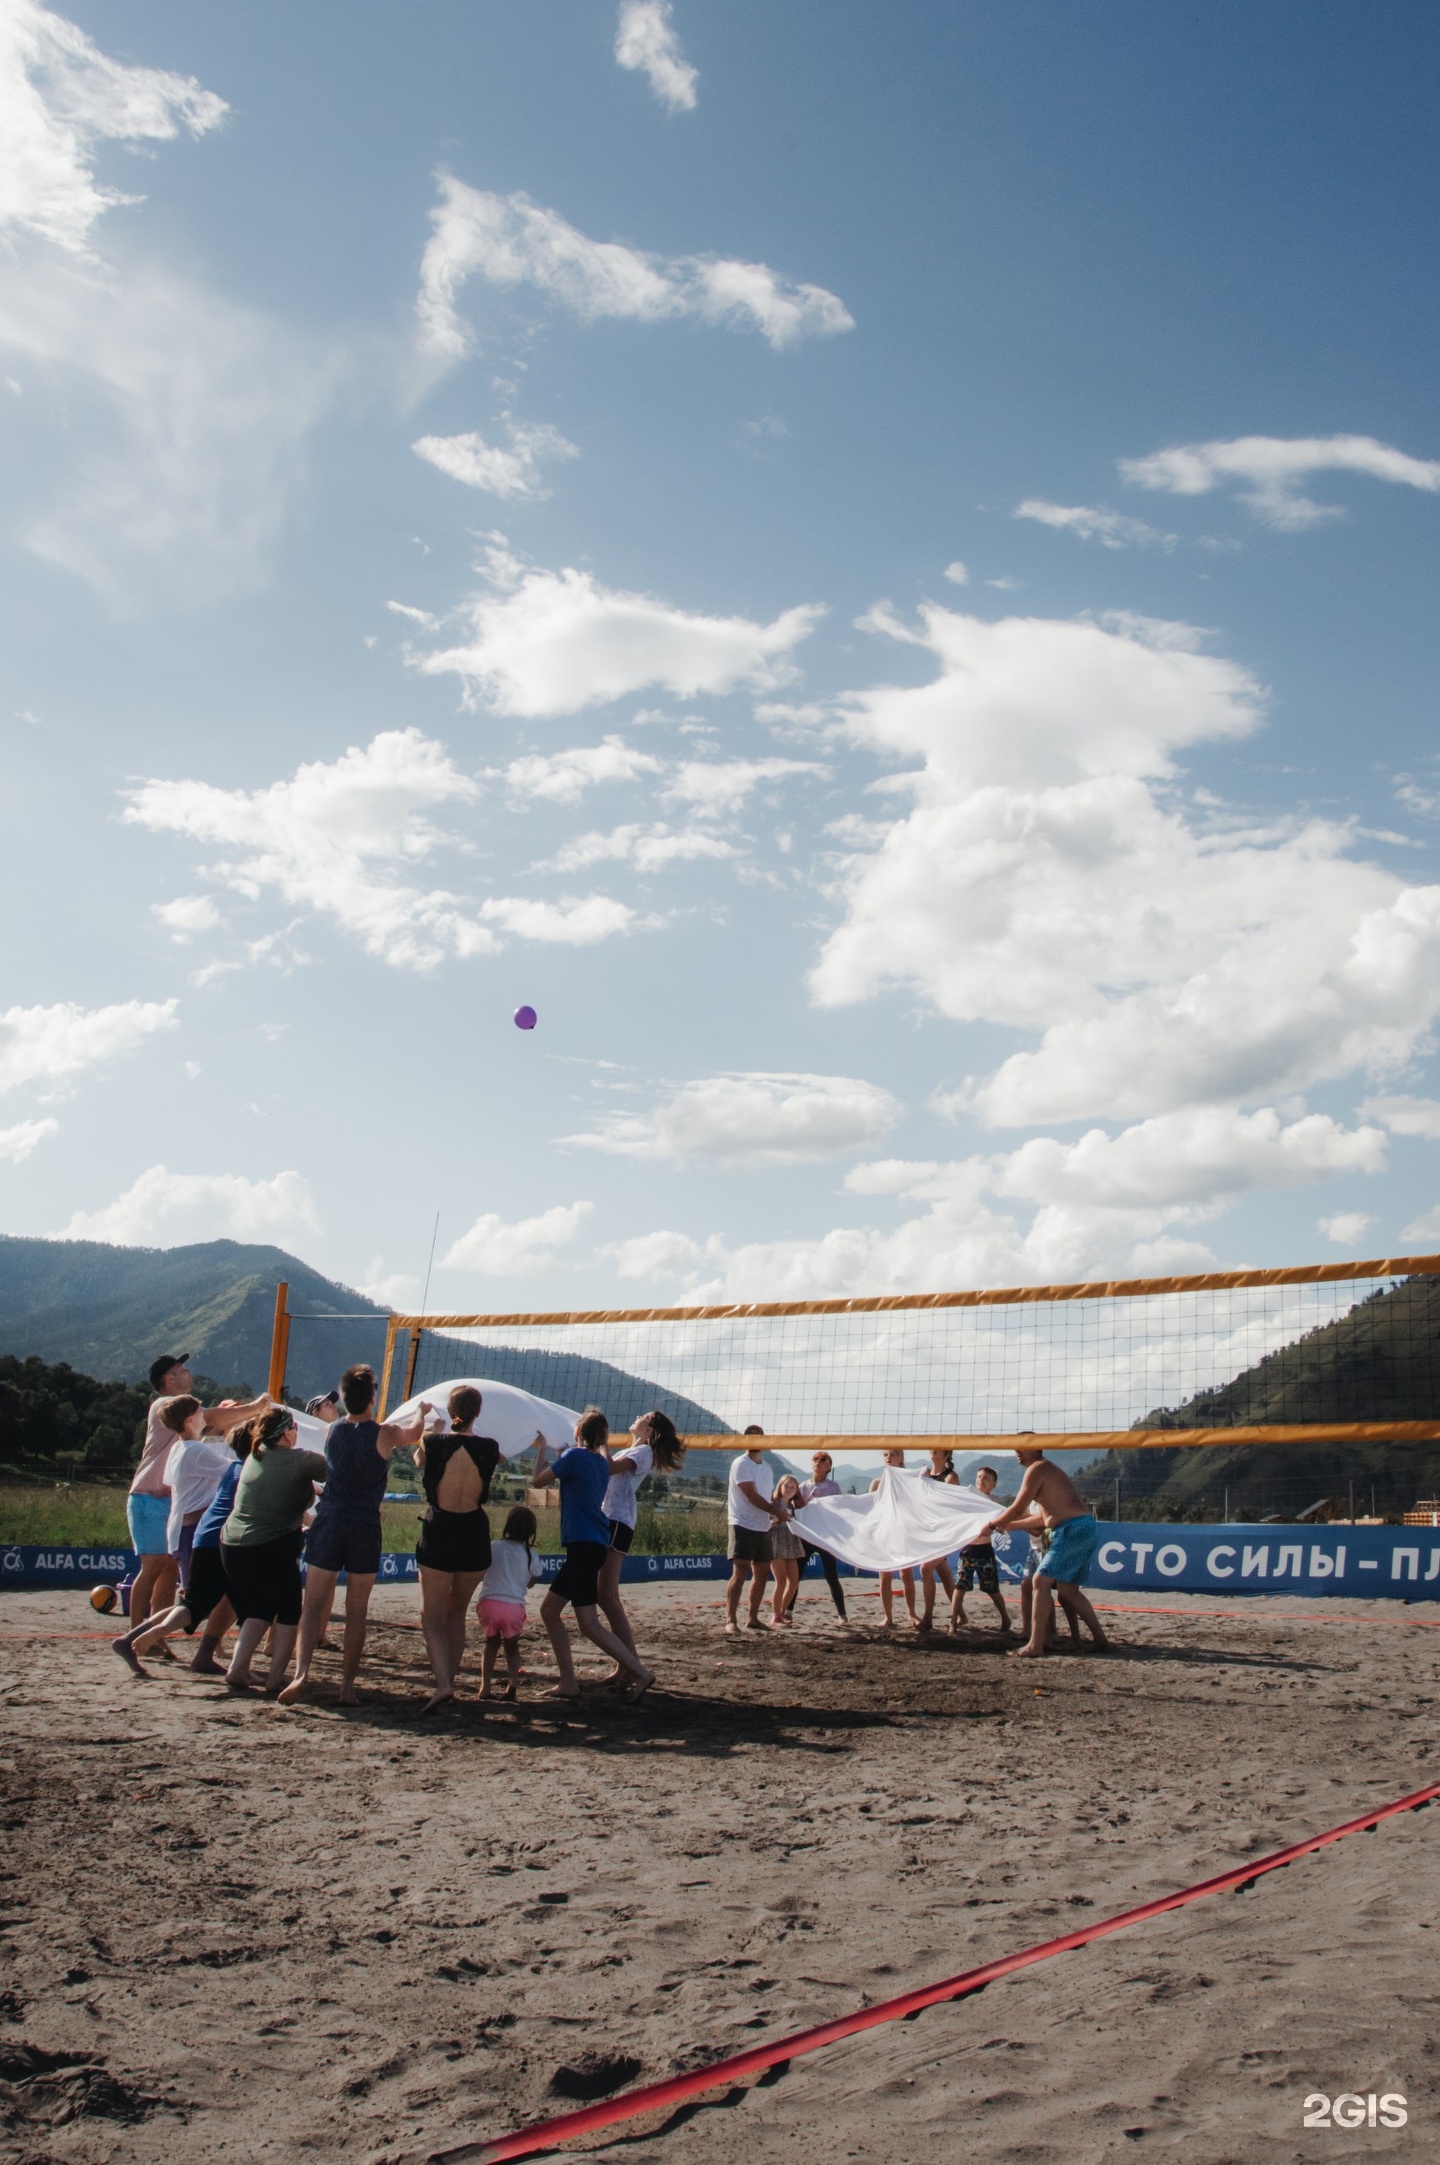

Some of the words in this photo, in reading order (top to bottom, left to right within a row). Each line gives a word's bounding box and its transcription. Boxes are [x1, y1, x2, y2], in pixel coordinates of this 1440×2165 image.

[35, 1553, 74, 1569] ALFA
[78, 1555, 126, 1570] CLASS
[541, 1559, 567, 1571] МЕС
[664, 1558, 685, 1570] ALFA
[686, 1557, 712, 1569] CLASS
[1090, 1541, 1187, 1576] СТО
[1206, 1545, 1346, 1578] СИЛЫ
